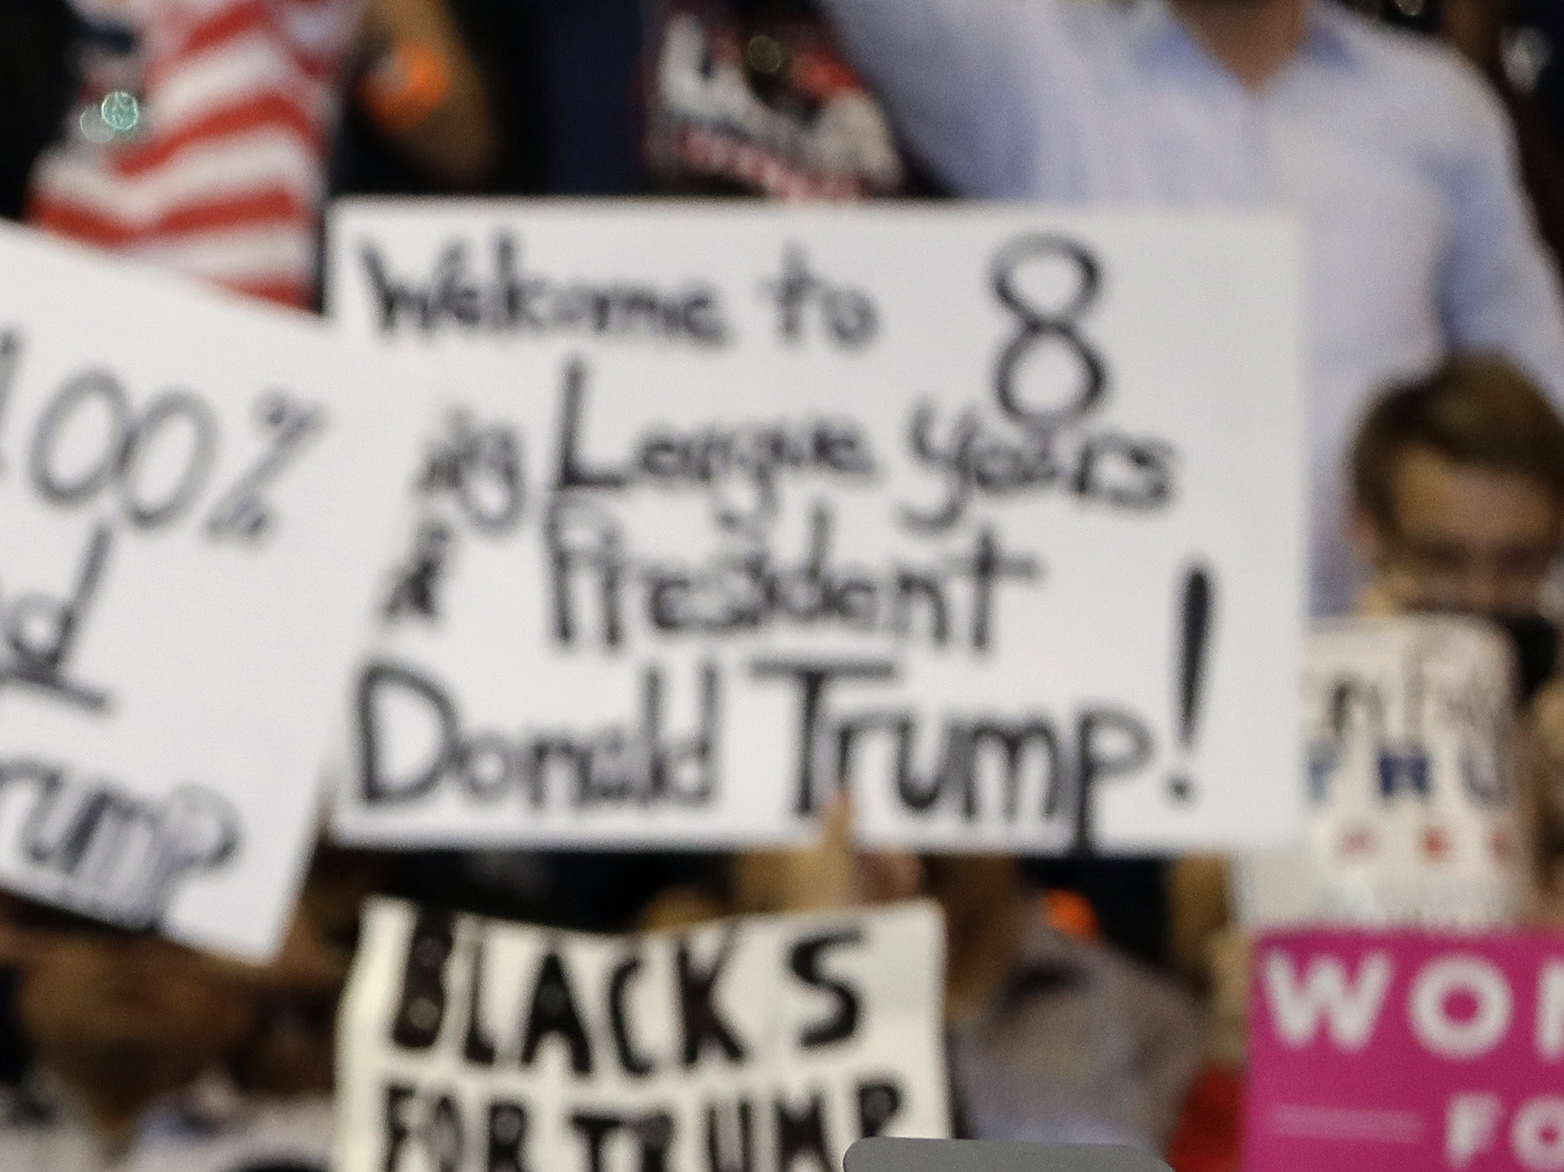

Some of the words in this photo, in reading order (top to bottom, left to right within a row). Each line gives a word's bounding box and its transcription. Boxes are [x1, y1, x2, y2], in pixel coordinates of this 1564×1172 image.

[358, 232, 734, 350] Welcome
[758, 240, 882, 352] to
[986, 228, 1110, 430] 8
[542, 492, 1042, 654] President
[354, 658, 722, 812] Donald
[388, 906, 866, 1078] BLACKS
[1260, 944, 1564, 1066] WO
